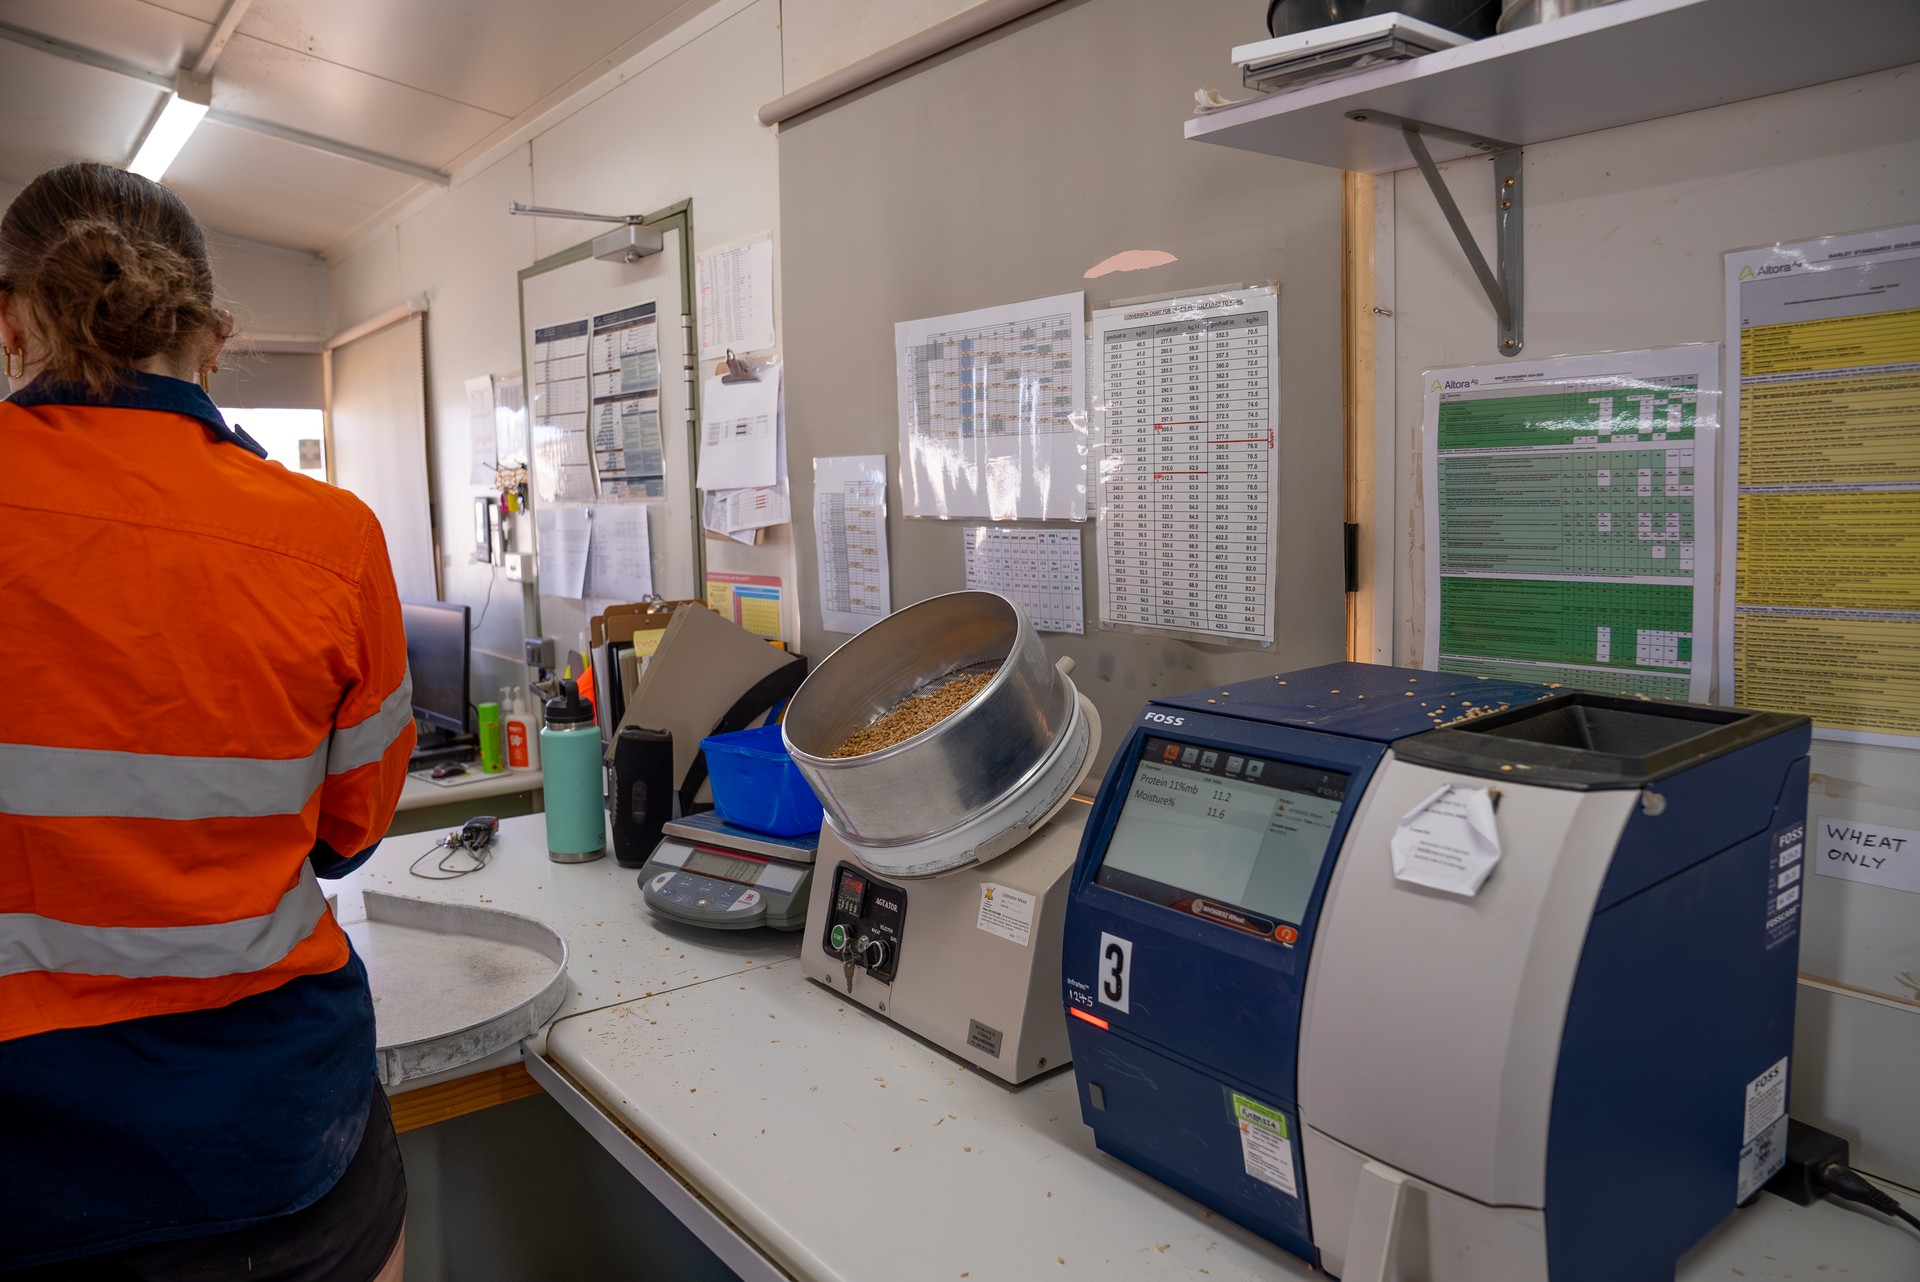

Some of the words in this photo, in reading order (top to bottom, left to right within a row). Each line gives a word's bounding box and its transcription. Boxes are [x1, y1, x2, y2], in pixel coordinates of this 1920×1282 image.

[1758, 264, 1791, 276] Altora
[1124, 311, 1148, 320] CONVERSION
[1444, 380, 1470, 389] Altora
[1144, 712, 1185, 726] FOSS
[1140, 773, 1168, 787] Protein
[1169, 780, 1198, 794] 11%mb
[1212, 790, 1232, 802] 11.2
[1317, 786, 1344, 799] FOSS
[1135, 789, 1176, 807] Moisture%
[1206, 807, 1226, 819] 11.6
[1779, 826, 1804, 848] FOSS
[1827, 824, 1907, 852] WHEAT
[1828, 849, 1886, 869] ONLY
[1002, 892, 1017, 901] Calibration
[1229, 913, 1245, 924] Wheat
[834, 932, 843, 941] START
[1104, 943, 1124, 1002] 3
[972, 1034, 995, 1048] ENGINEERING
[1754, 1065, 1780, 1093] FOSS
